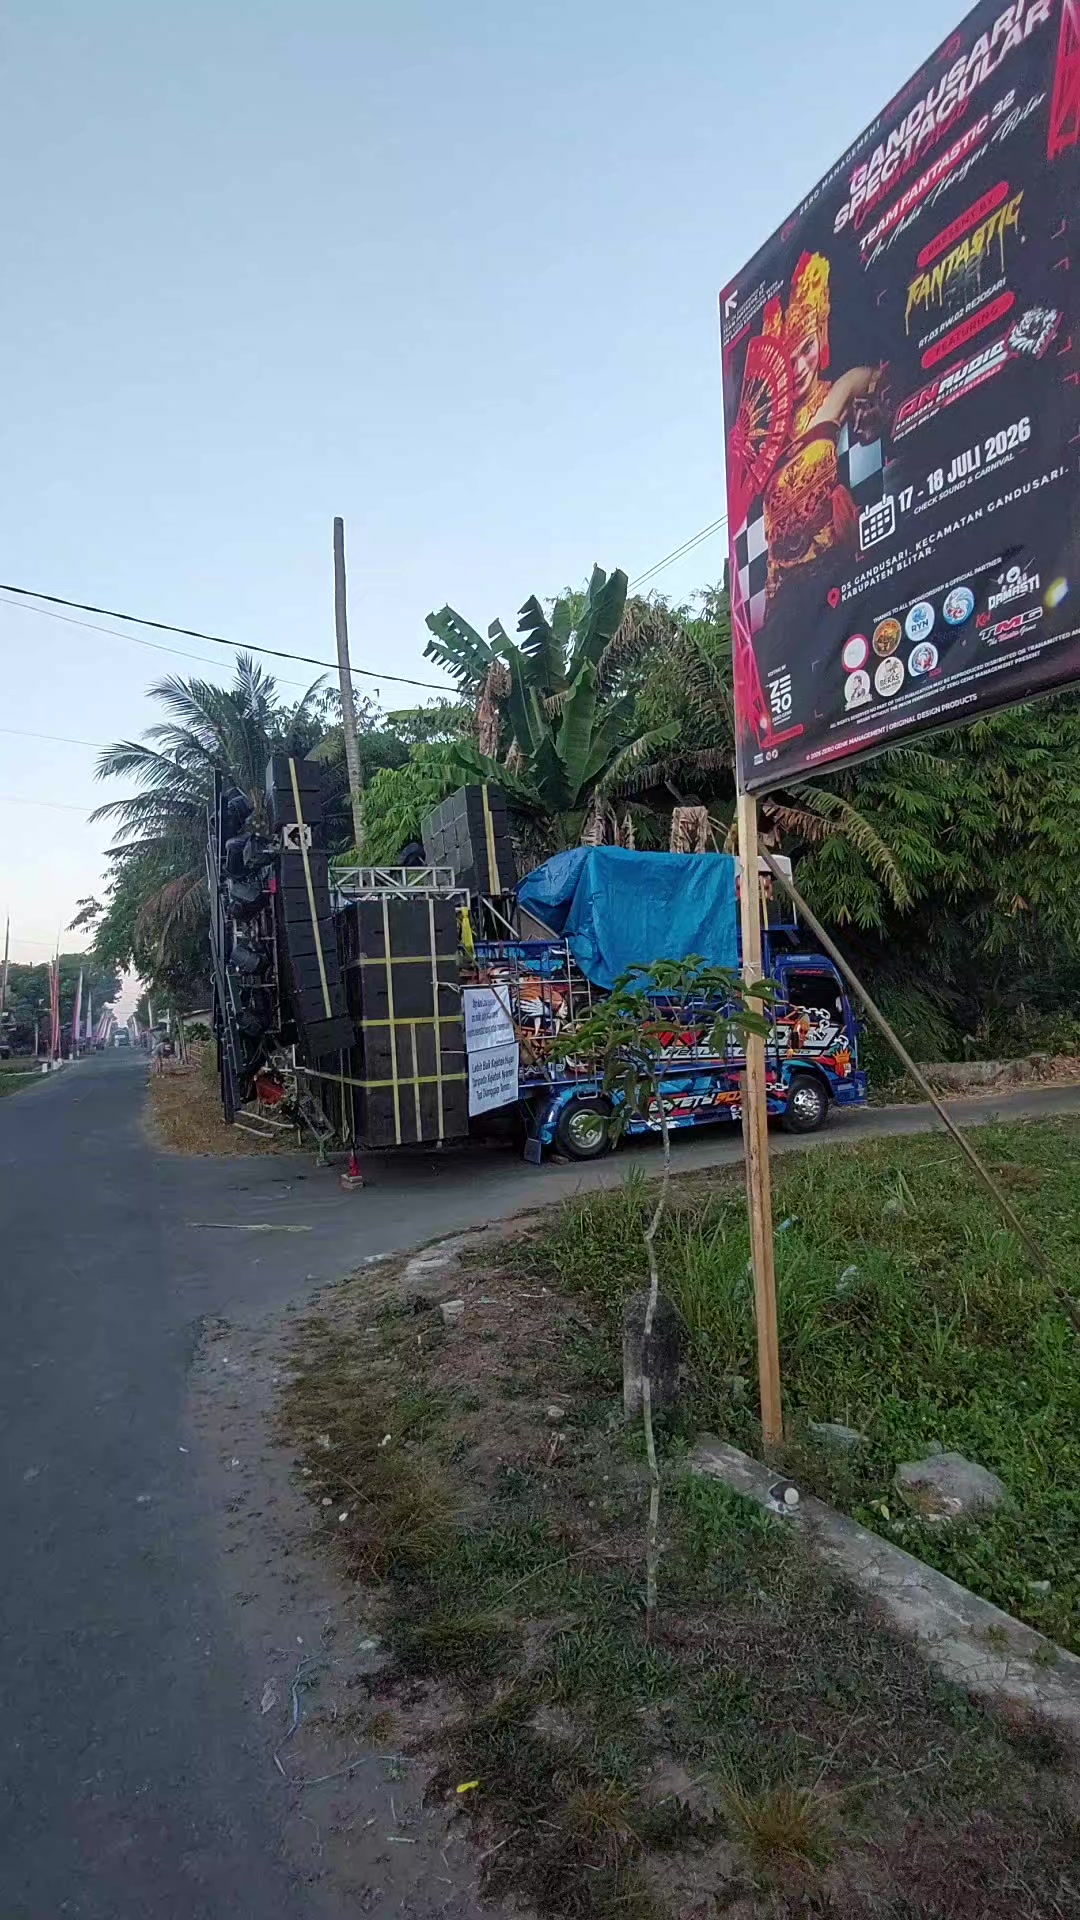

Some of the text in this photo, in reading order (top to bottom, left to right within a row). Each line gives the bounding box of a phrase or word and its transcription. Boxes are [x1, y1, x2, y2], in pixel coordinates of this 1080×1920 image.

[833, 0, 1051, 235] SPECTACULAR
[849, 0, 1025, 195] GANDUSARI
[858, 204, 899, 251] TEAM
[900, 114, 989, 212] FANTASTIC
[905, 188, 1024, 335] FANTASTIC
[898, 485, 914, 513] 17
[927, 468, 944, 496] 18
[947, 444, 980, 483] JULI
[984, 416, 1031, 463] 2026
[913, 495, 938, 515] CHECK
[938, 480, 967, 501] SOUND
[974, 453, 1015, 480] CARNIVAL
[841, 581, 852, 593] DS
[915, 507, 984, 551] KECAMATAN
[841, 566, 893, 603] KABUPATEN
[873, 611, 893, 624] THANKS
[898, 602, 909, 613] ALL
[949, 572, 975, 587] OFFICIAL
[974, 556, 1002, 575] PARTNER
[911, 618, 929, 633] RYN
[889, 717, 916, 734] ORIGINAL
[916, 706, 941, 722] DESIGN
[941, 693, 978, 711] PRODUCTS
